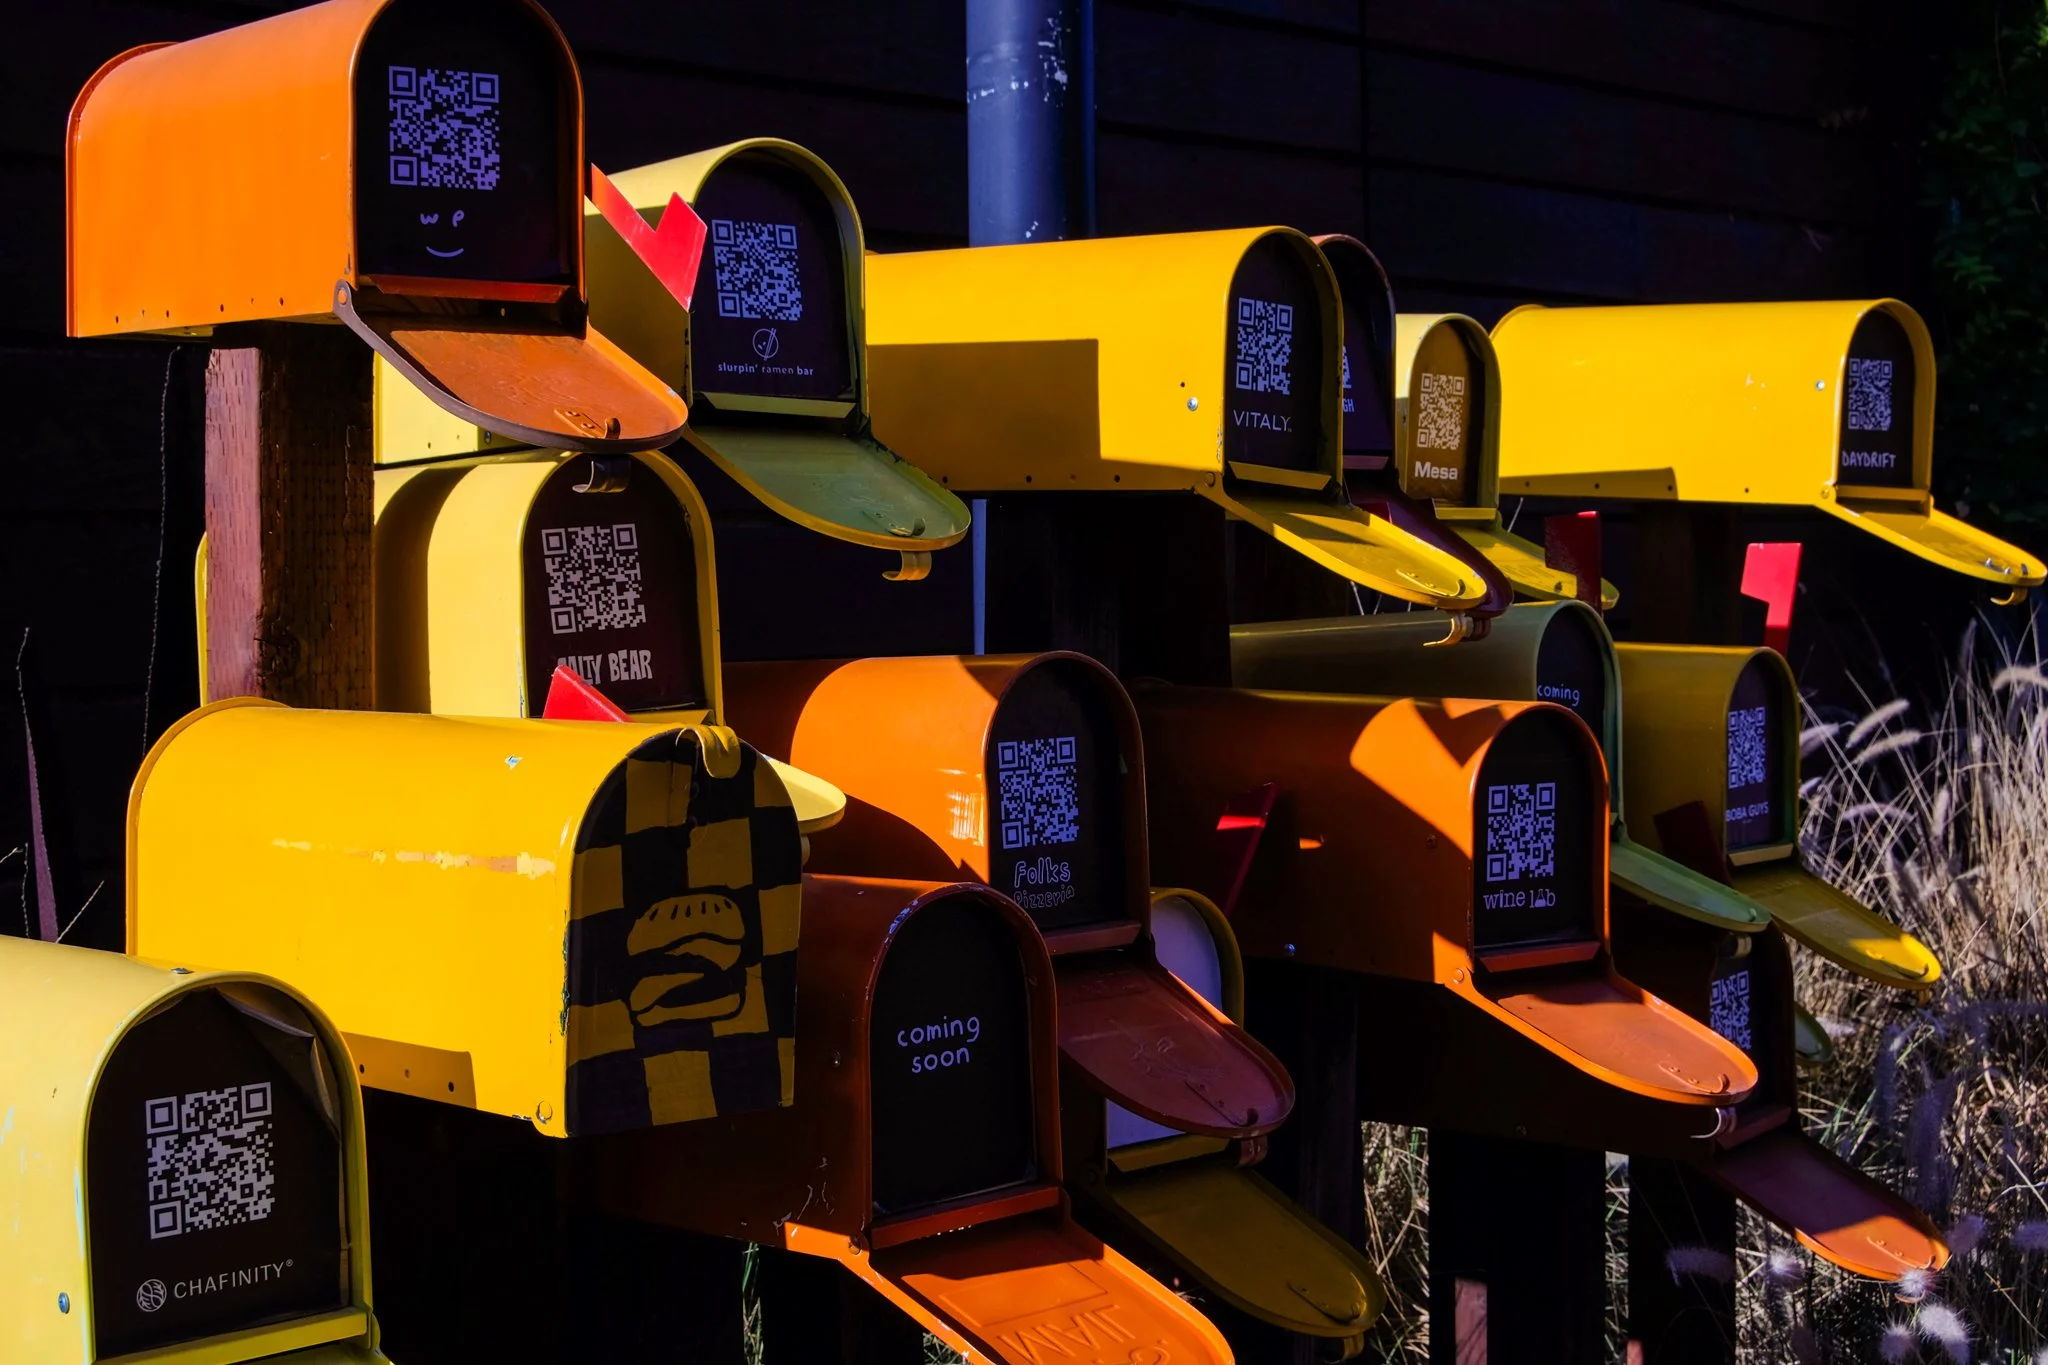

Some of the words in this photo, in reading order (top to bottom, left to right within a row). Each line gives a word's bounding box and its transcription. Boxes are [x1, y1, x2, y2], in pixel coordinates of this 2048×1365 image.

[718, 361, 758, 374] slurpin'
[761, 366, 794, 374] ramen
[796, 364, 814, 376] bar
[1233, 409, 1291, 432] VITALY
[1414, 460, 1458, 480] Mesa
[1841, 449, 1896, 469] DAYDRIFT
[607, 648, 653, 682] BEAR
[1537, 683, 1580, 707] coming
[1014, 856, 1071, 889] Folks
[1482, 889, 1526, 910] wine
[897, 1015, 980, 1048] coming
[911, 1046, 970, 1074] soon
